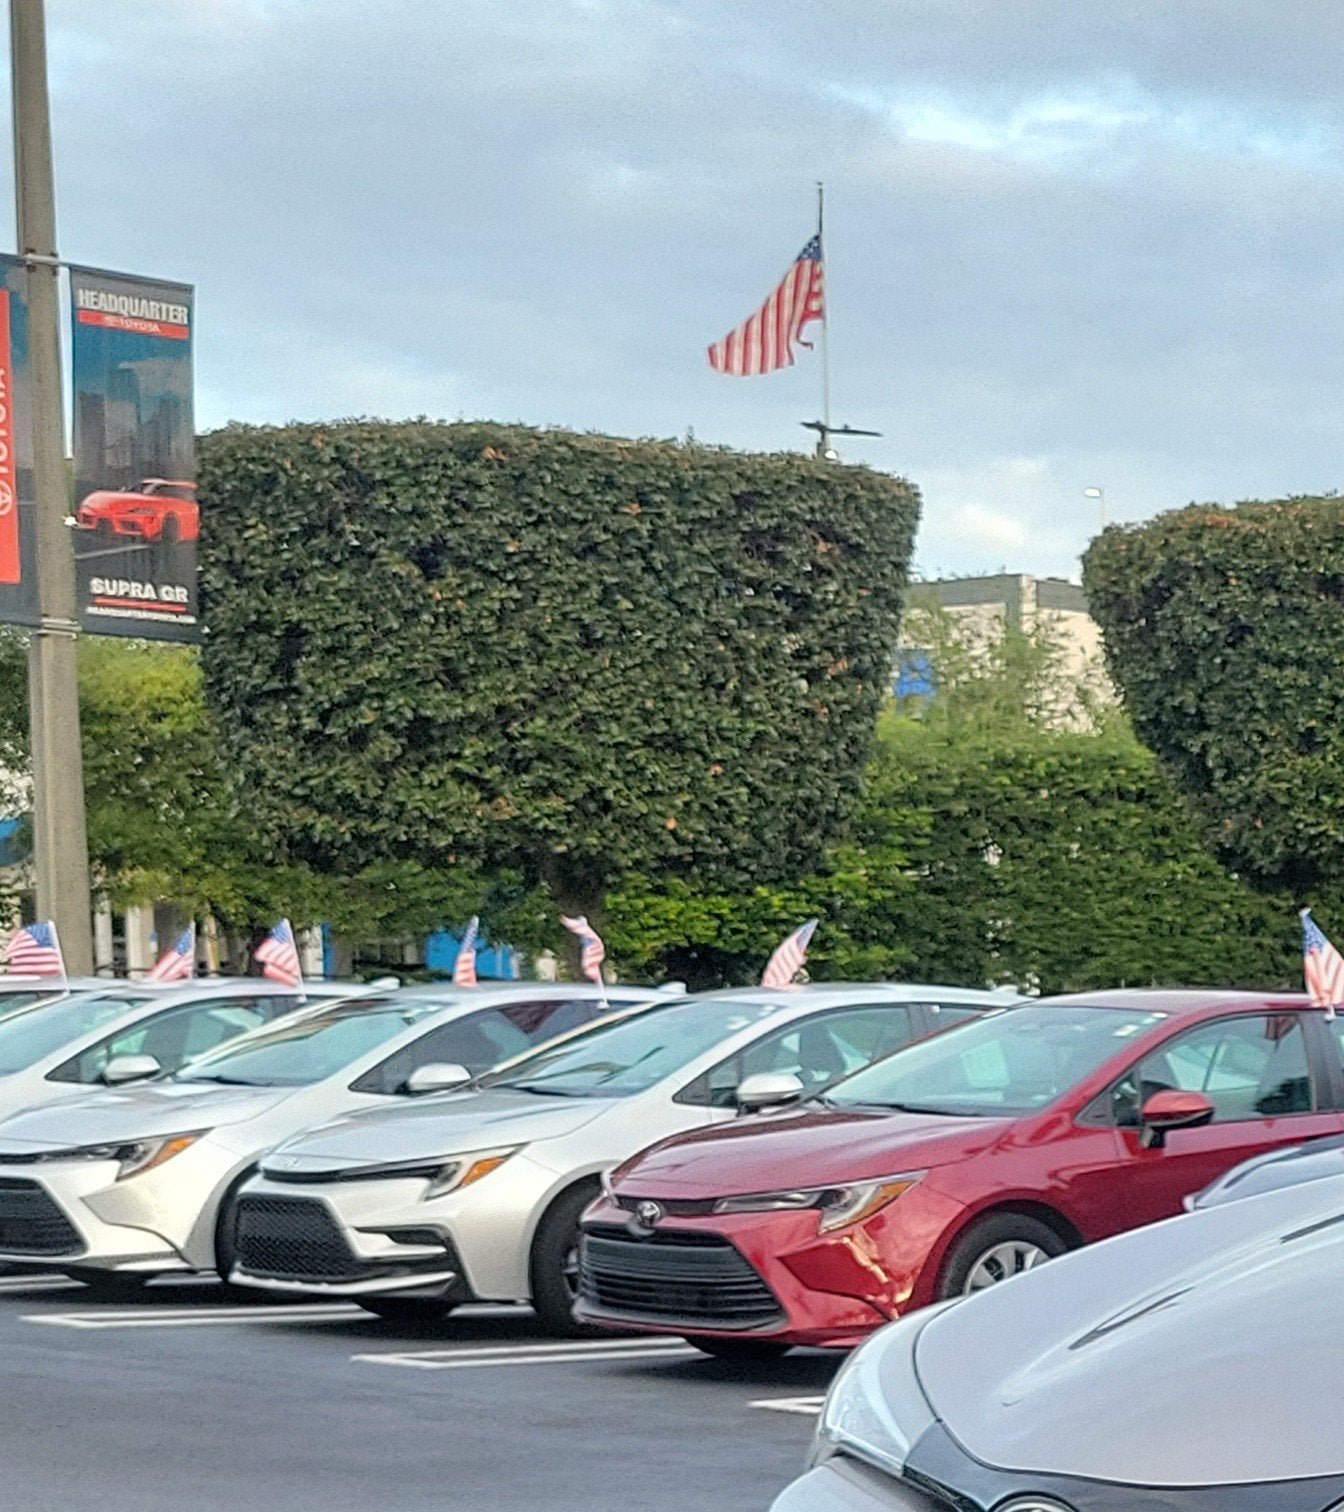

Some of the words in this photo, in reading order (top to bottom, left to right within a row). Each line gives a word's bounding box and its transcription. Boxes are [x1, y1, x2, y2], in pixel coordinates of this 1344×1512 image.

[79, 289, 188, 325] HEADQUARTER
[90, 577, 158, 600] SUPRA
[160, 585, 188, 603] GR
